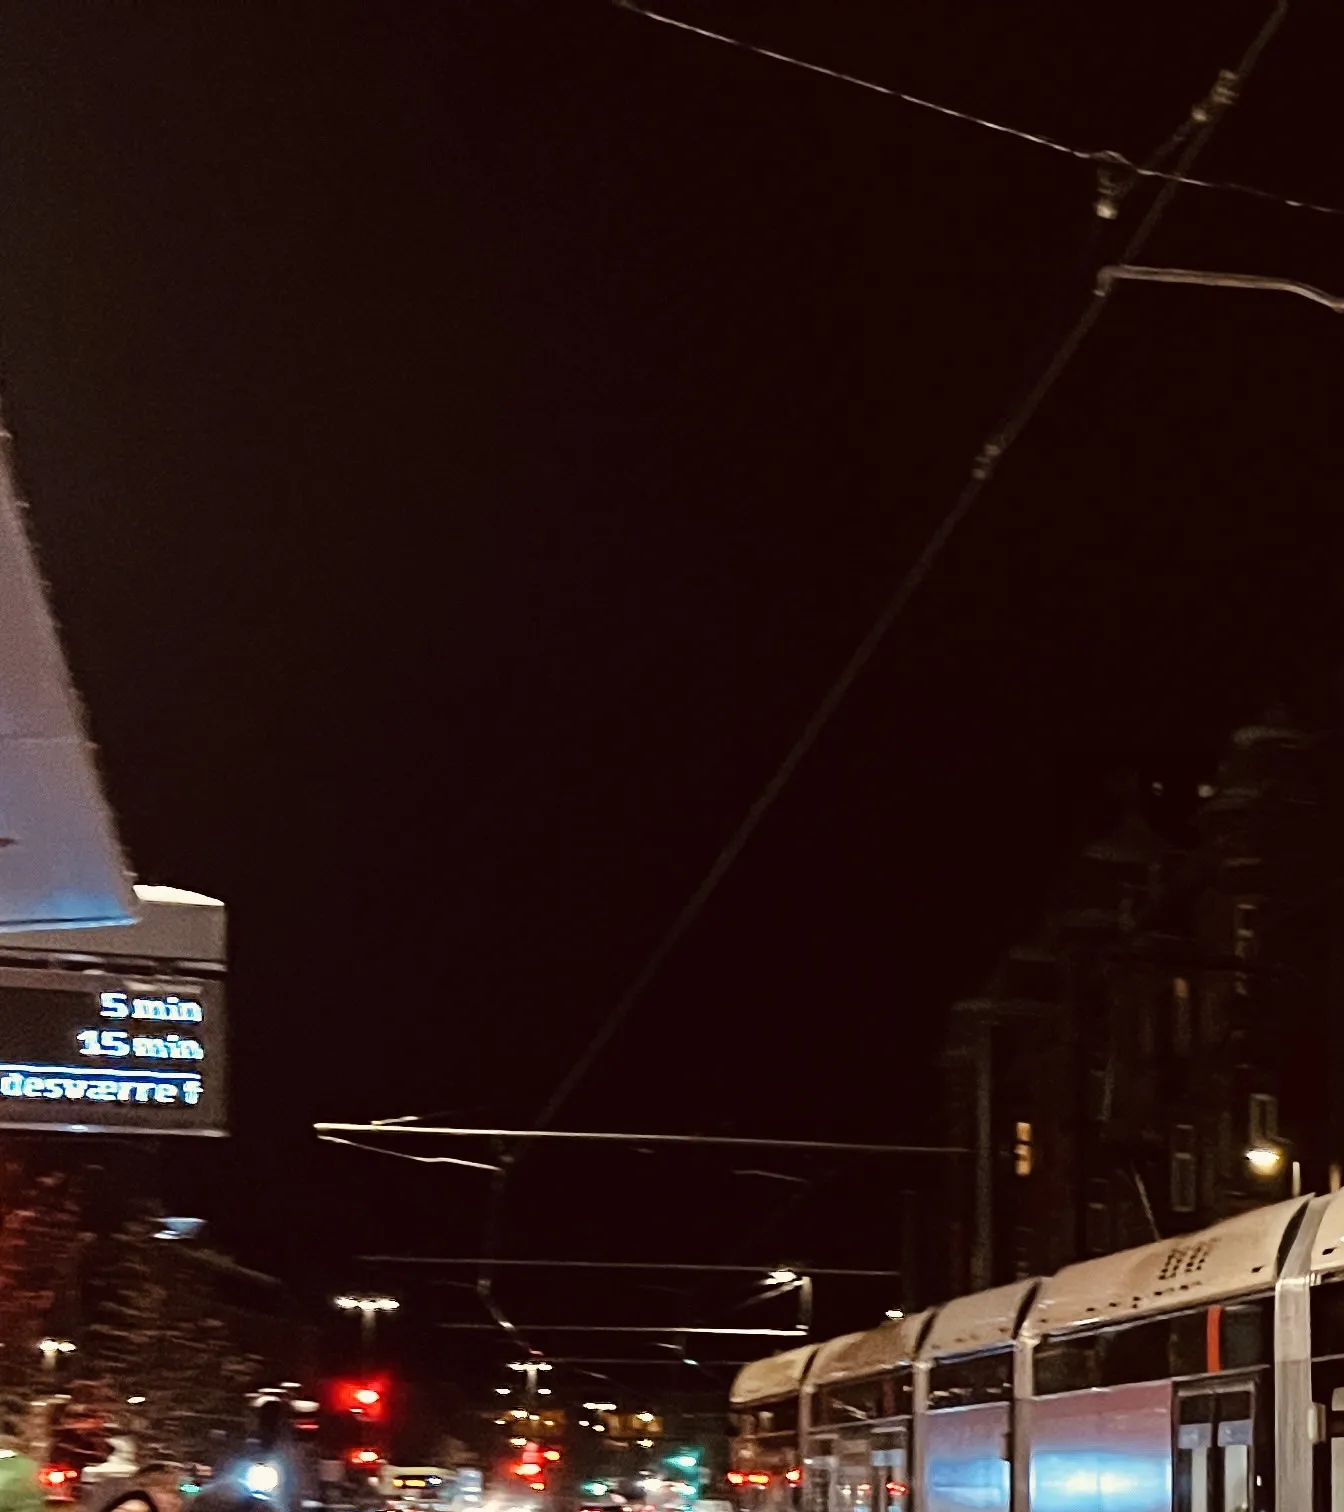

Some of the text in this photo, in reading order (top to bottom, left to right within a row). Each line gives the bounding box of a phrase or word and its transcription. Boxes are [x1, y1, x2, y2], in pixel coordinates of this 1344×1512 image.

[99, 992, 204, 1023] 5 min
[76, 1029, 205, 1061] 15 min
[0, 1072, 179, 1103] desværre
